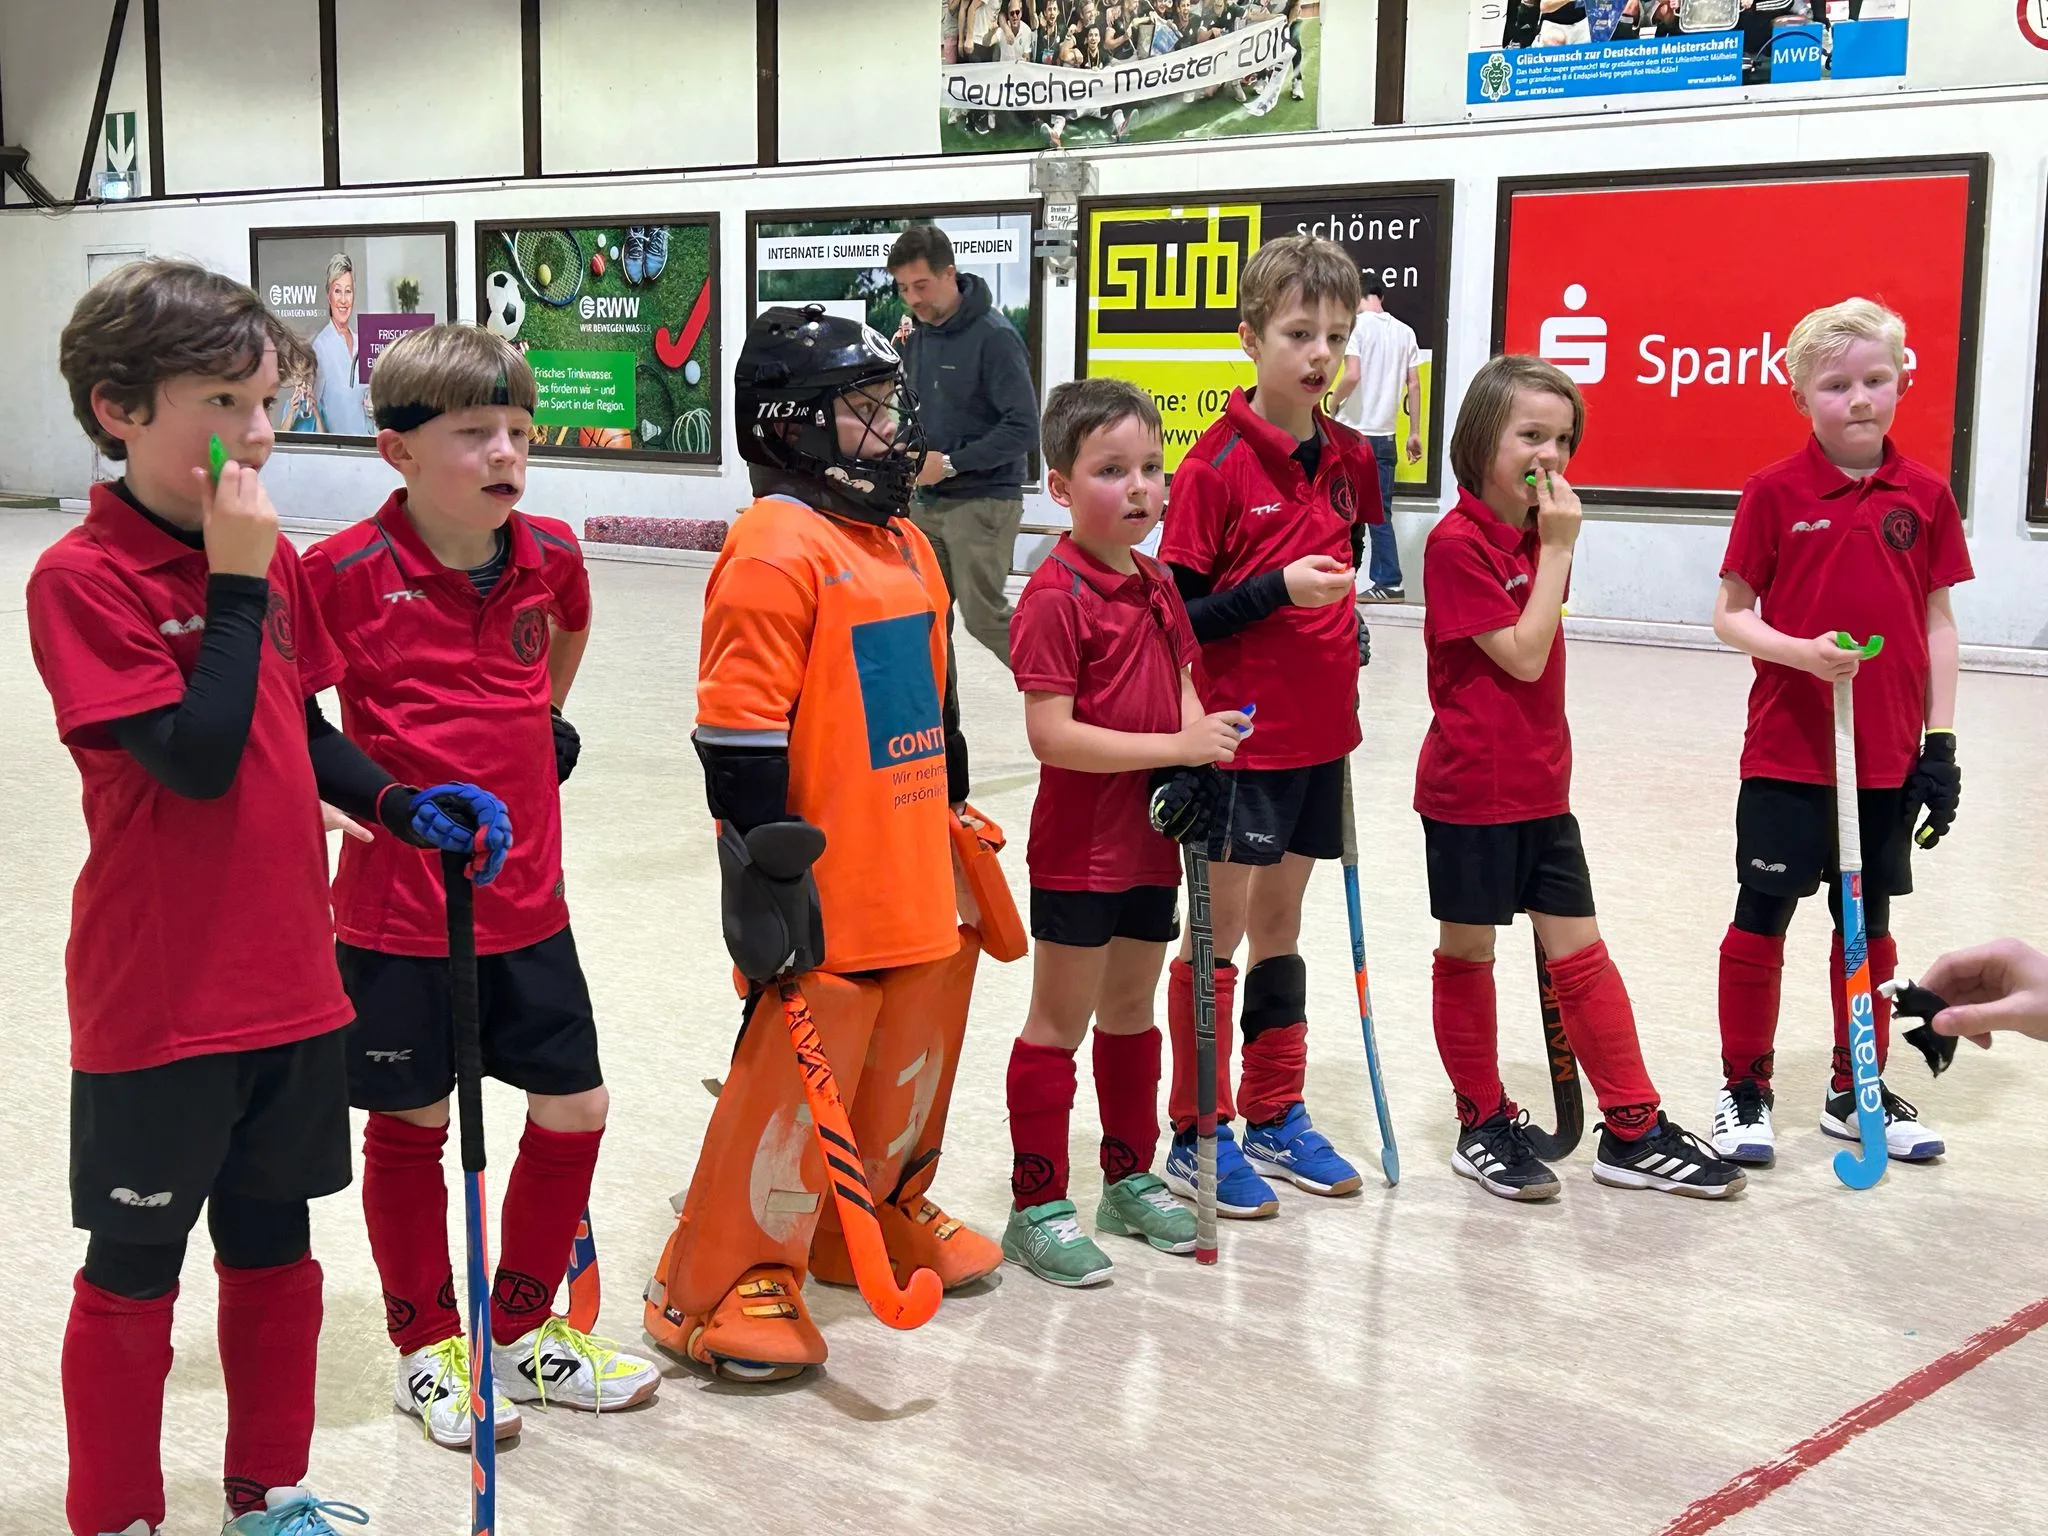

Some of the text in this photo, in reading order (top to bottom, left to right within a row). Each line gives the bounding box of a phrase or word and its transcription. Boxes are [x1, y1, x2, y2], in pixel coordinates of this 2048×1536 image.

[1516, 37, 1739, 65] Glückwunsch zur Deutschen Meisterschaft!
[1660, 57, 1675, 65] HTC
[1773, 46, 1821, 65] MWB
[947, 72, 1104, 108] Deutscher
[1114, 51, 1232, 95] Meister
[1296, 213, 1421, 242] schöner
[768, 246, 825, 260] INTERNATE
[833, 244, 880, 258] SUMMER
[953, 239, 1013, 254] TIPENDIEN
[1362, 266, 1418, 288] en
[282, 284, 317, 305] RWW
[596, 296, 640, 319] RWW
[593, 323, 624, 333] BEWEGEN
[534, 366, 613, 380] Frisches Trinkwasser.
[1636, 331, 1918, 398] Sparke
[550, 382, 578, 395] fördern
[579, 385, 592, 395] wir
[600, 384, 616, 396] und
[551, 397, 573, 411] Sport
[573, 399, 581, 409] in
[581, 399, 595, 411] der
[597, 400, 625, 414] Region.
[892, 770, 912, 786] Wir
[1245, 832, 1276, 844] TK
